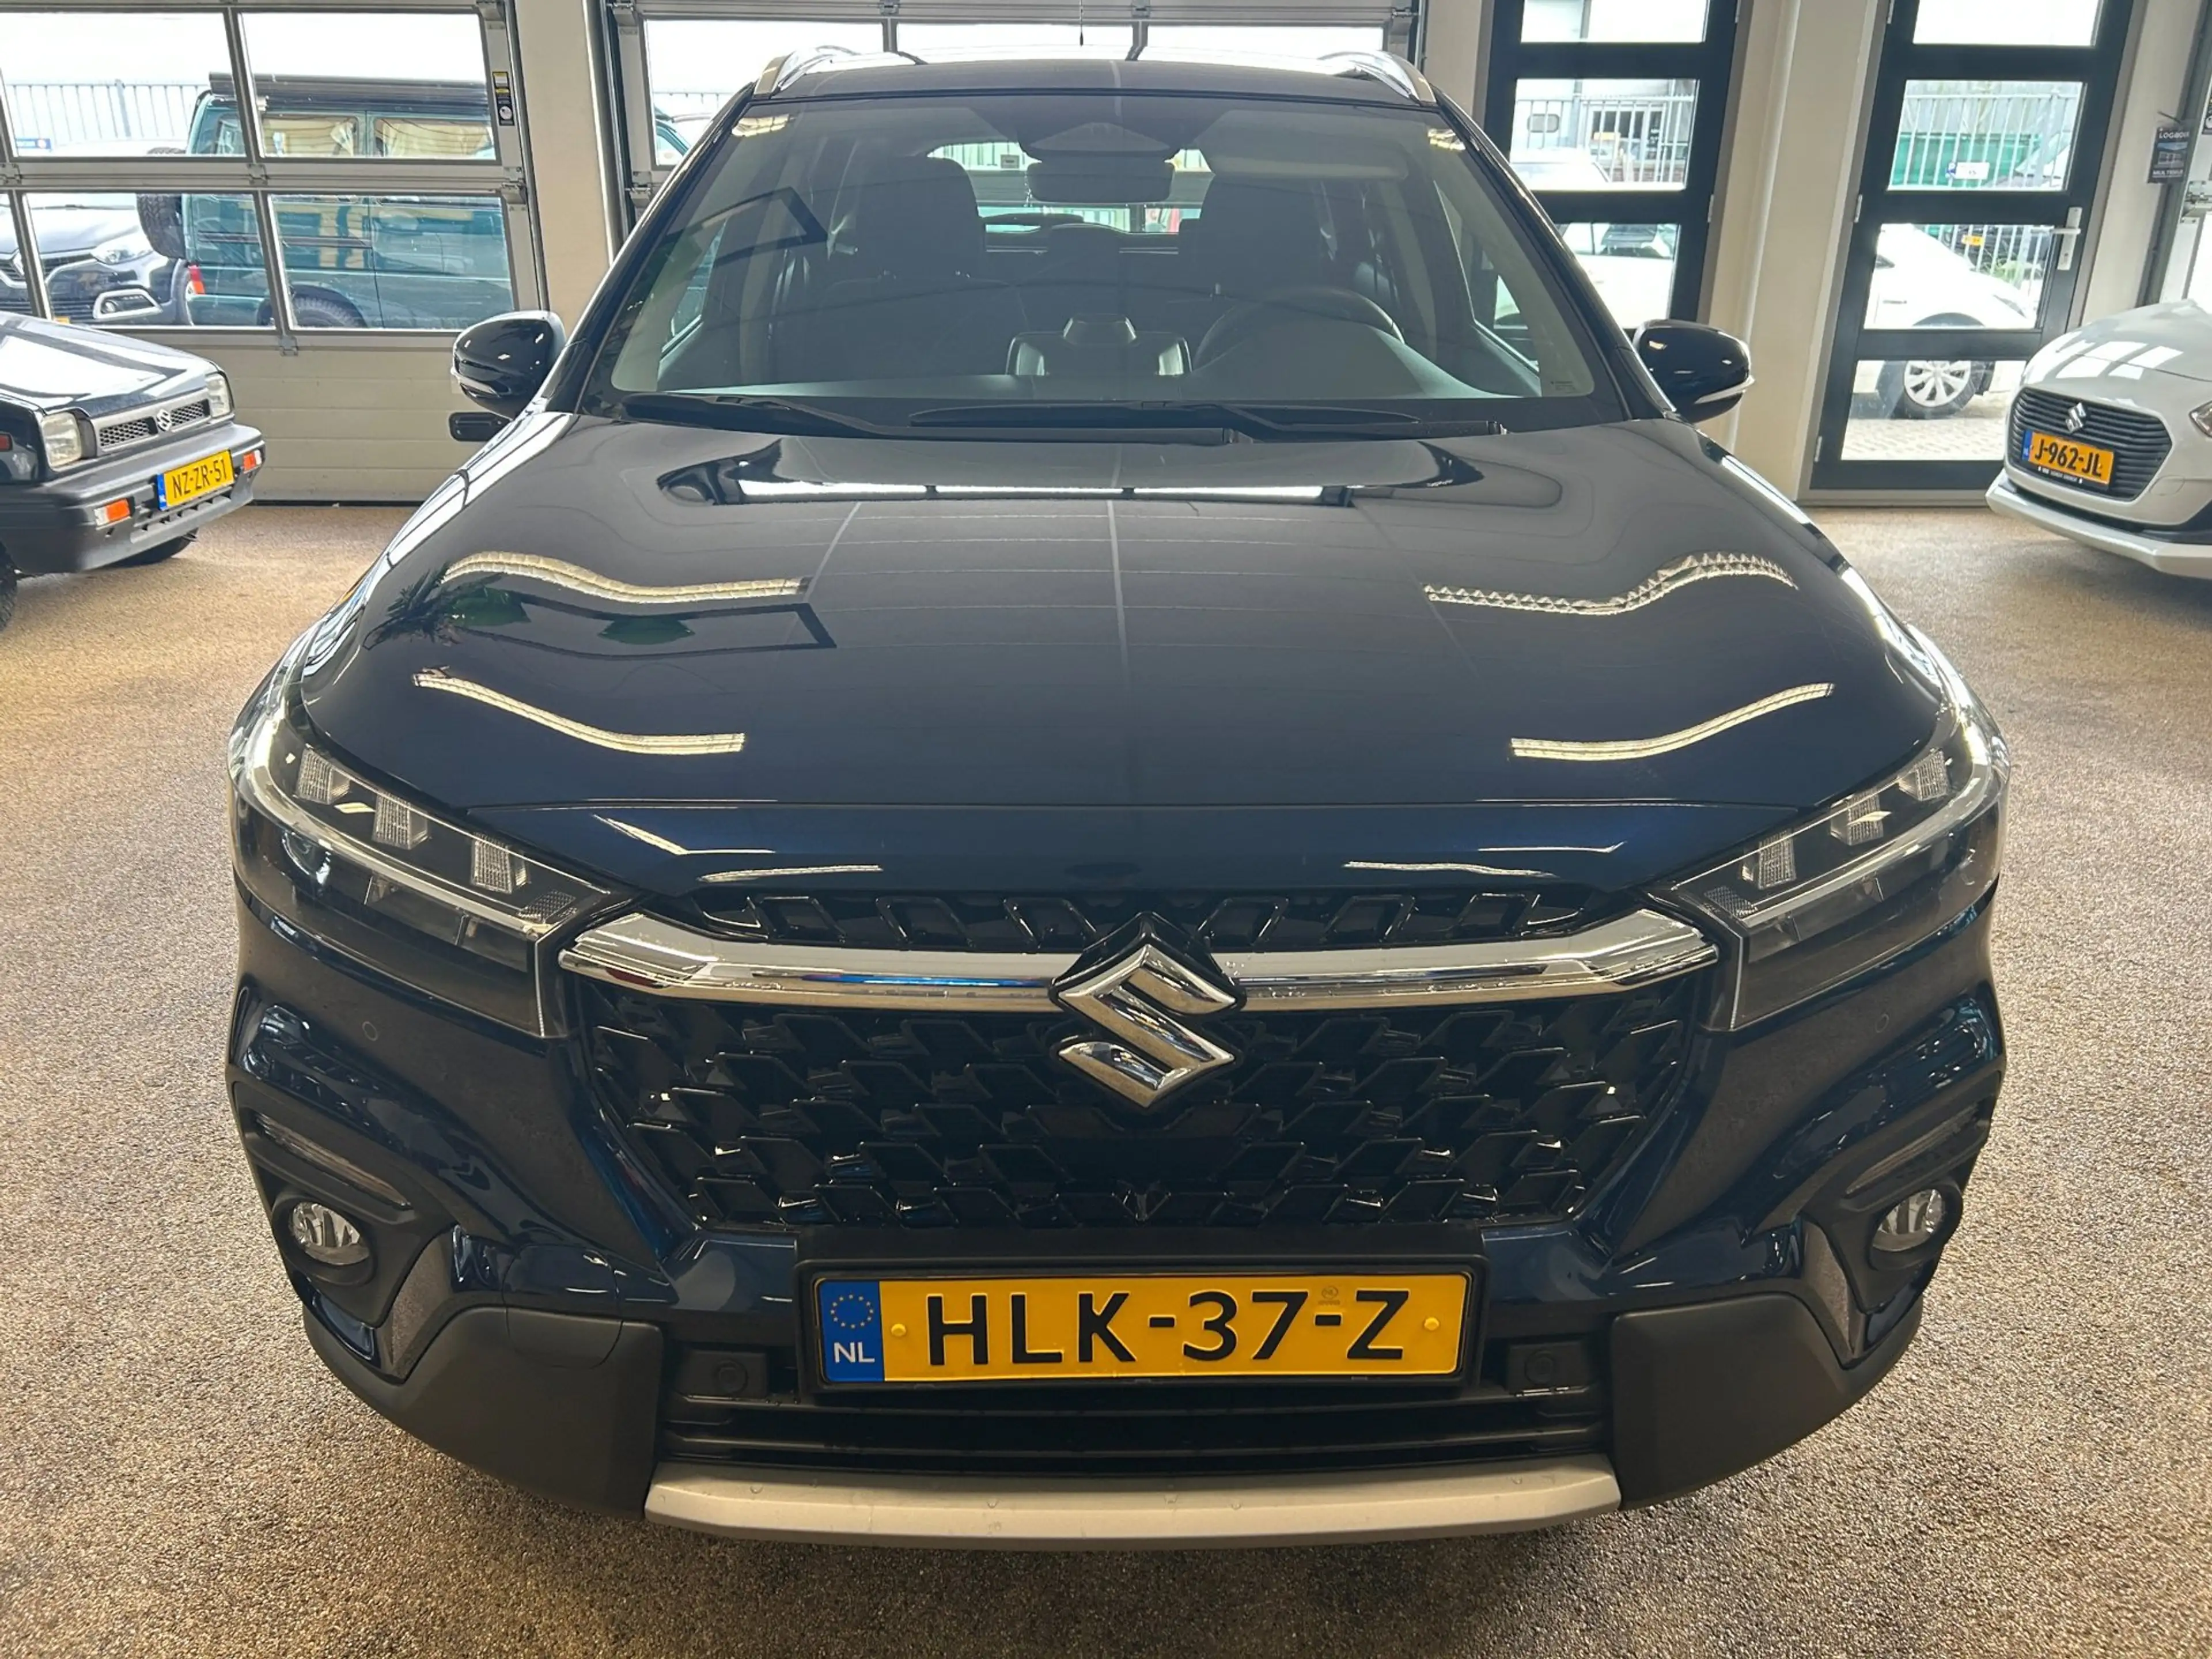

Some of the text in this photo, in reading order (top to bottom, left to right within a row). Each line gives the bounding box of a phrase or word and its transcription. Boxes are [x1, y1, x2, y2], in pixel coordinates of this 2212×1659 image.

[2035, 438, 2101, 477] J-962-JL
[172, 459, 227, 498] NZ-ZR-51
[927, 1290, 1409, 1365] HLK-37-Z
[834, 1342, 875, 1363] NL
